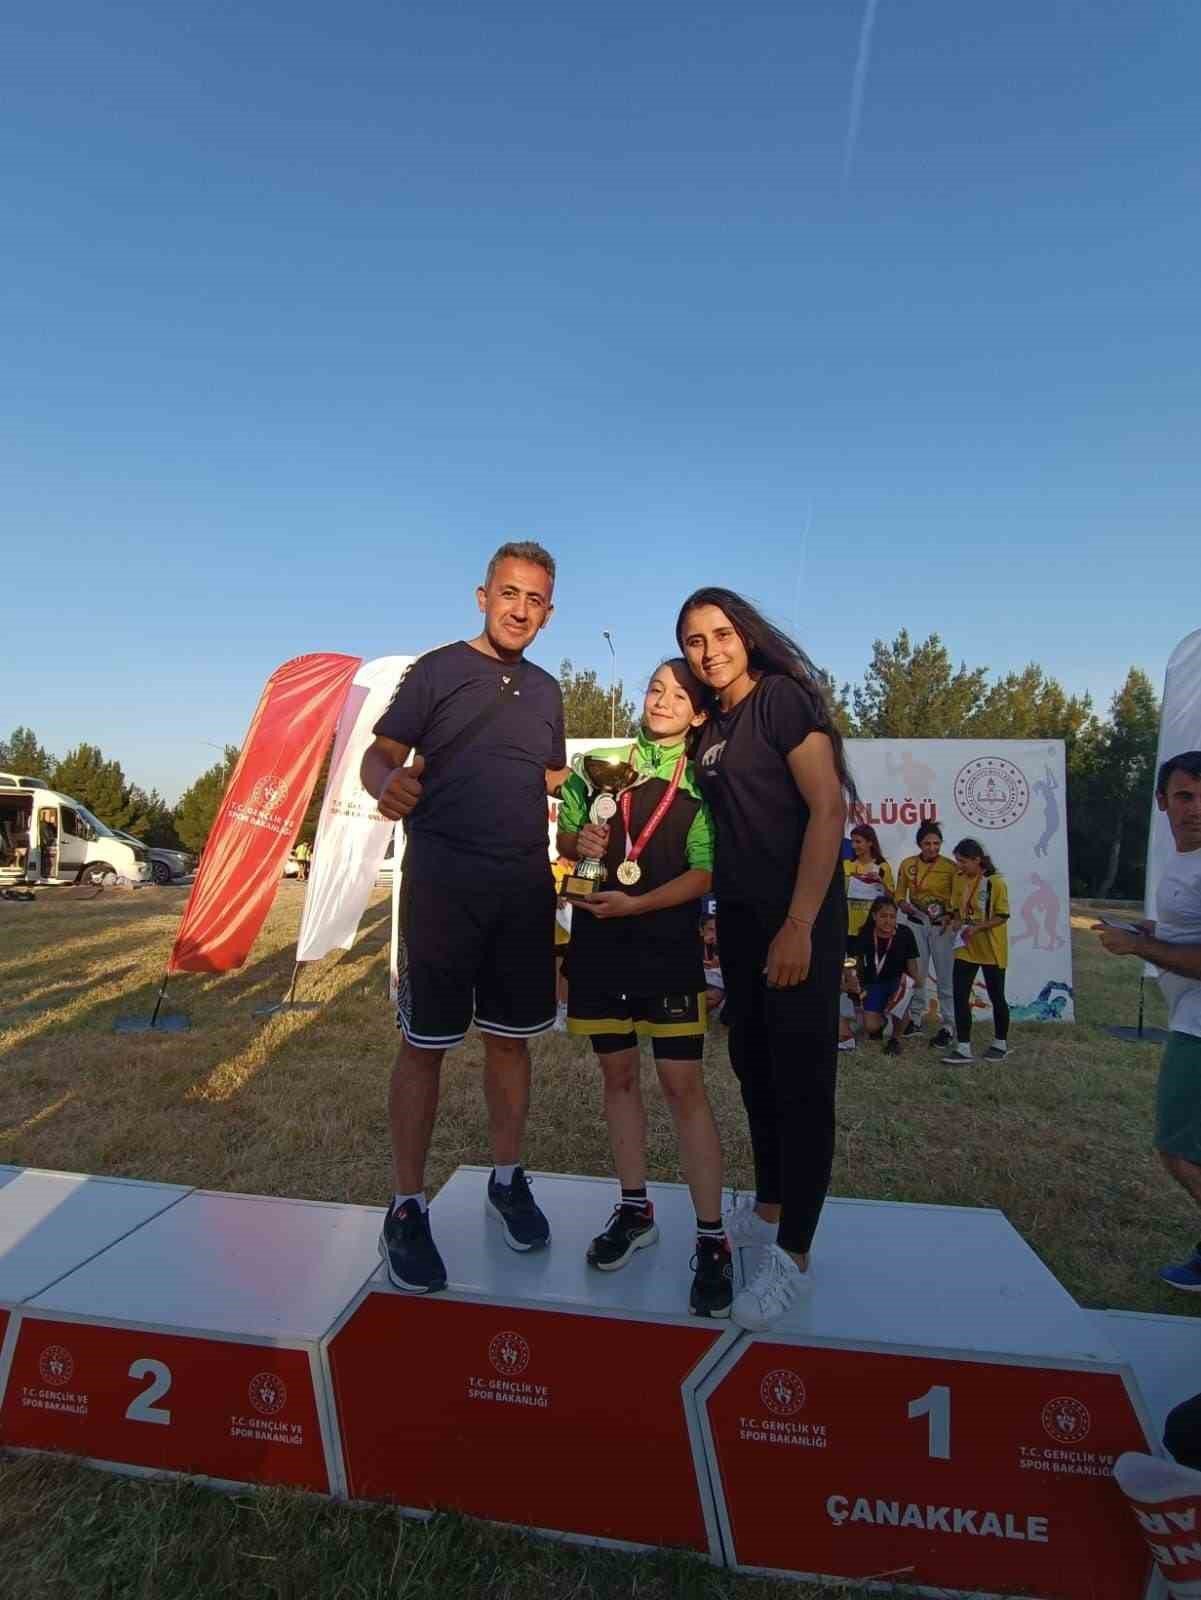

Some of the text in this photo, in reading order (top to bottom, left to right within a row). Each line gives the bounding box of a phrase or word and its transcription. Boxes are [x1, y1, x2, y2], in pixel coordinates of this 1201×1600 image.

[125, 1358, 172, 1424] 2
[468, 1389, 494, 1400] SPOR
[534, 1384, 548, 1395] VE
[22, 1398, 43, 1408] SPOR
[77, 1394, 88, 1404] VE
[739, 1417, 759, 1428] T.C.
[812, 1425, 826, 1436] VE
[908, 1384, 951, 1460] 1
[231, 1427, 254, 1438] SPOR
[290, 1424, 302, 1434] VE
[740, 1430, 767, 1441] SPOR
[1018, 1446, 1040, 1457] T.C.
[1019, 1459, 1050, 1472] SPOR
[826, 1494, 1049, 1543] ÇANAKKALE
